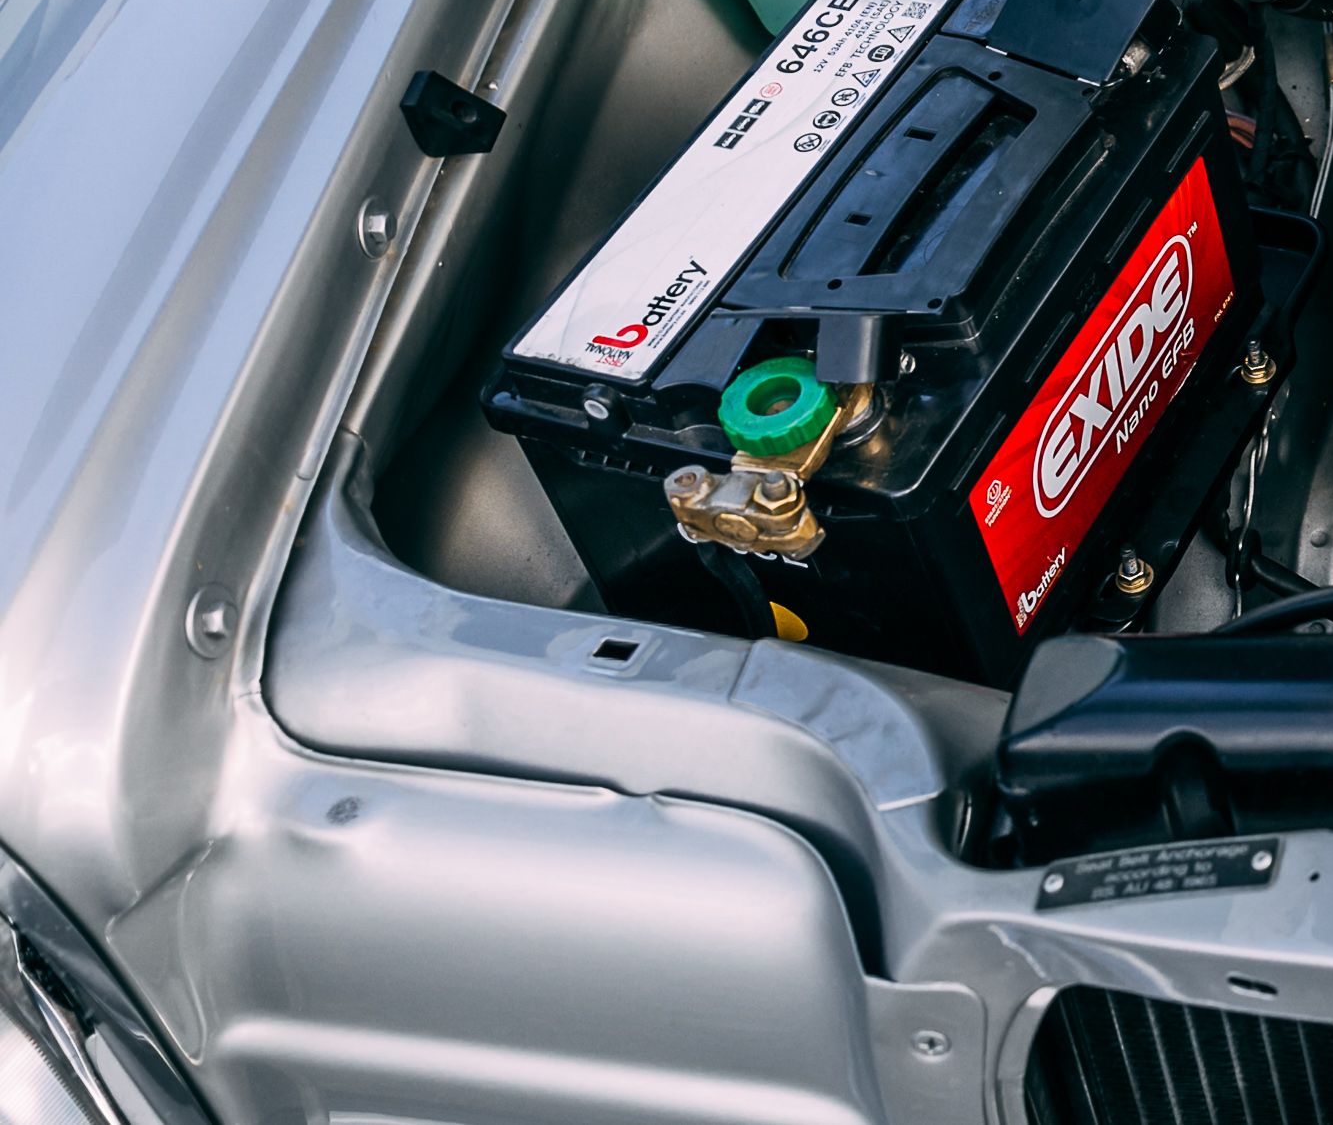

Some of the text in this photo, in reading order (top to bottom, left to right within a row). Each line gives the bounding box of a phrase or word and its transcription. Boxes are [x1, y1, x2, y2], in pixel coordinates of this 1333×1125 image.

[814, 59, 828, 73] 12V
[835, 62, 853, 78] EFB
[850, 0, 904, 60] TECHNOLOGY
[592, 260, 708, 349] battery
[1041, 249, 1184, 500] EXIDE
[1114, 317, 1196, 455] Nano EFB
[1020, 547, 1065, 613] battery
